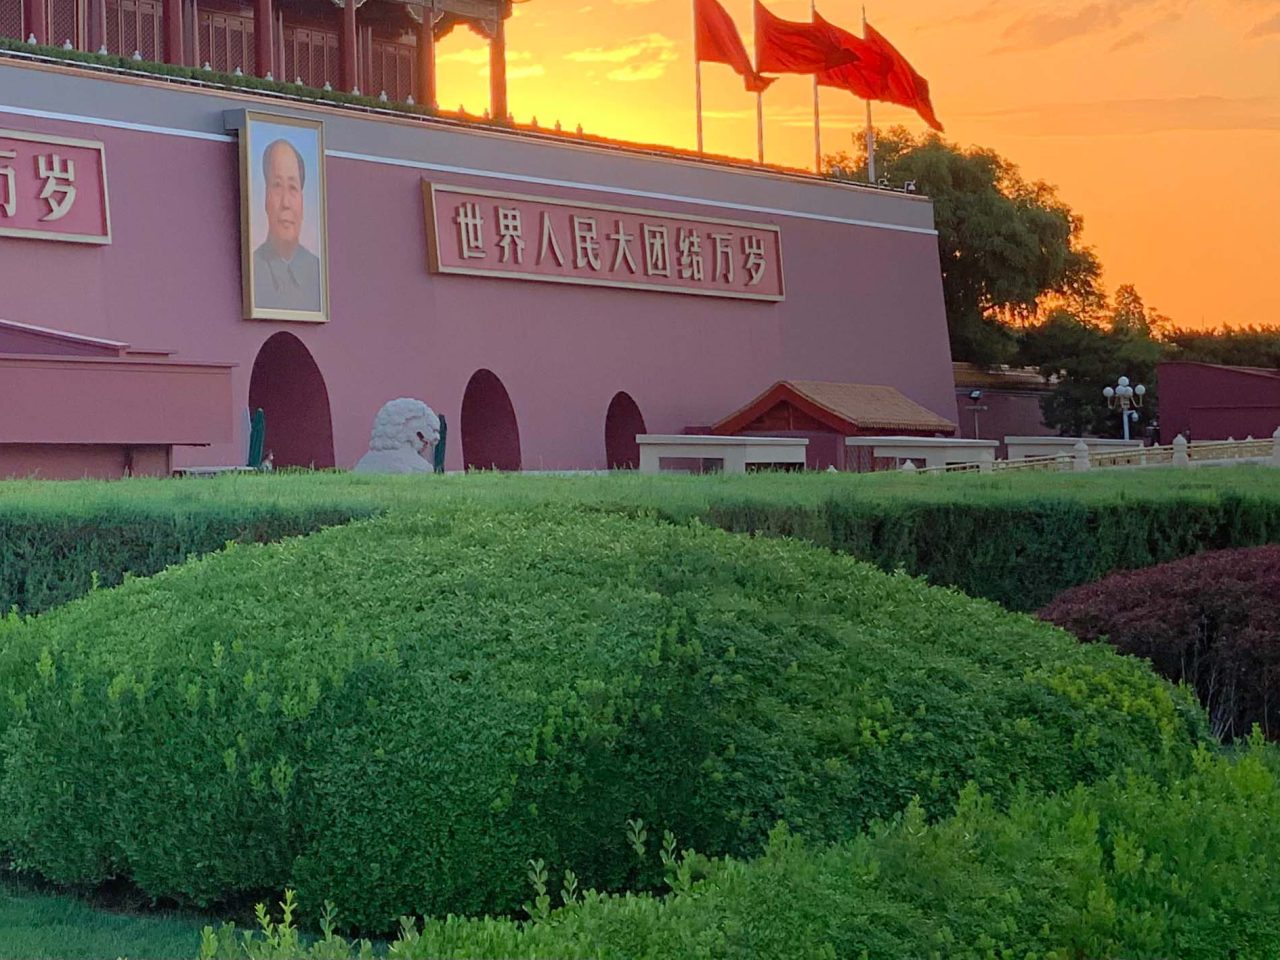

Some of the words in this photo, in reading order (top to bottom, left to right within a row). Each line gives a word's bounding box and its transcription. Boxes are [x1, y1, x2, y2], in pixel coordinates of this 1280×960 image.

[456, 202, 767, 286] 世界人民大团结万岁
